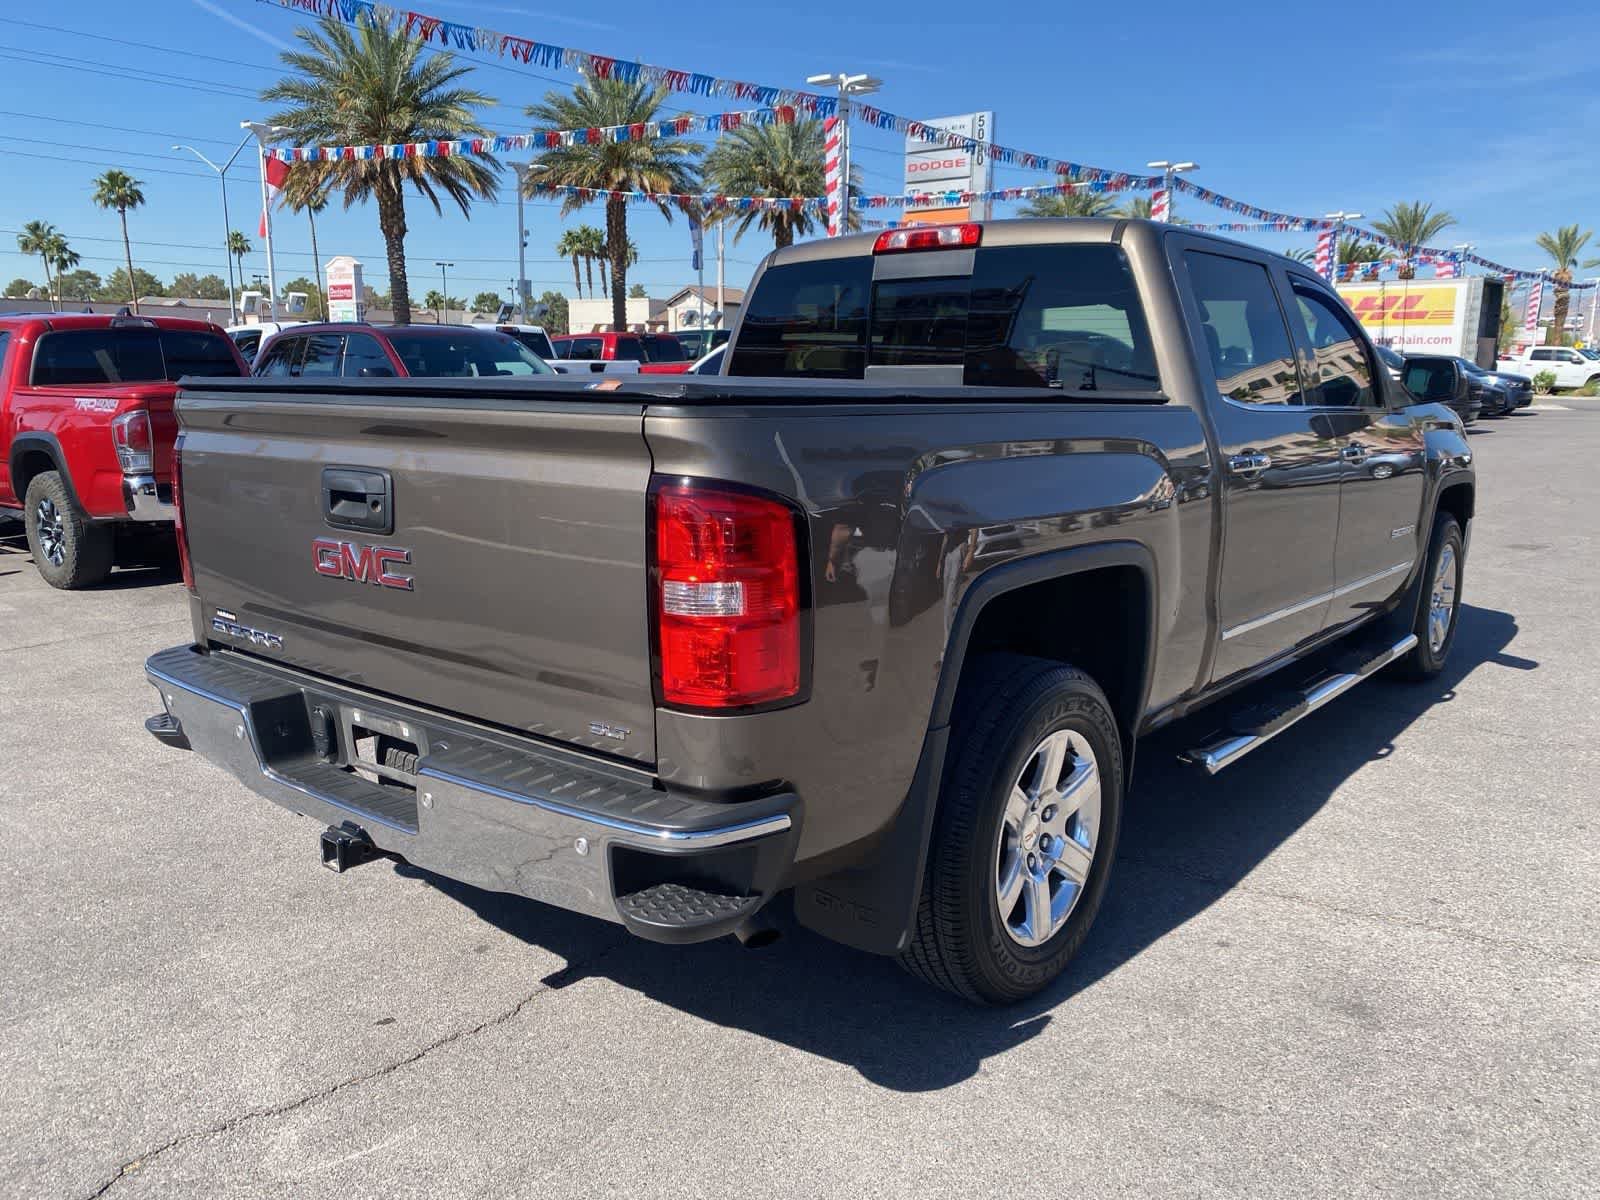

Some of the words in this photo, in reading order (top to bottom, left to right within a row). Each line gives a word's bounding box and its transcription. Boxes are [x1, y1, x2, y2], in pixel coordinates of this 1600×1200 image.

[907, 158, 967, 173] DODGE
[1341, 294, 1429, 320] HL
[311, 536, 414, 591] GMC
